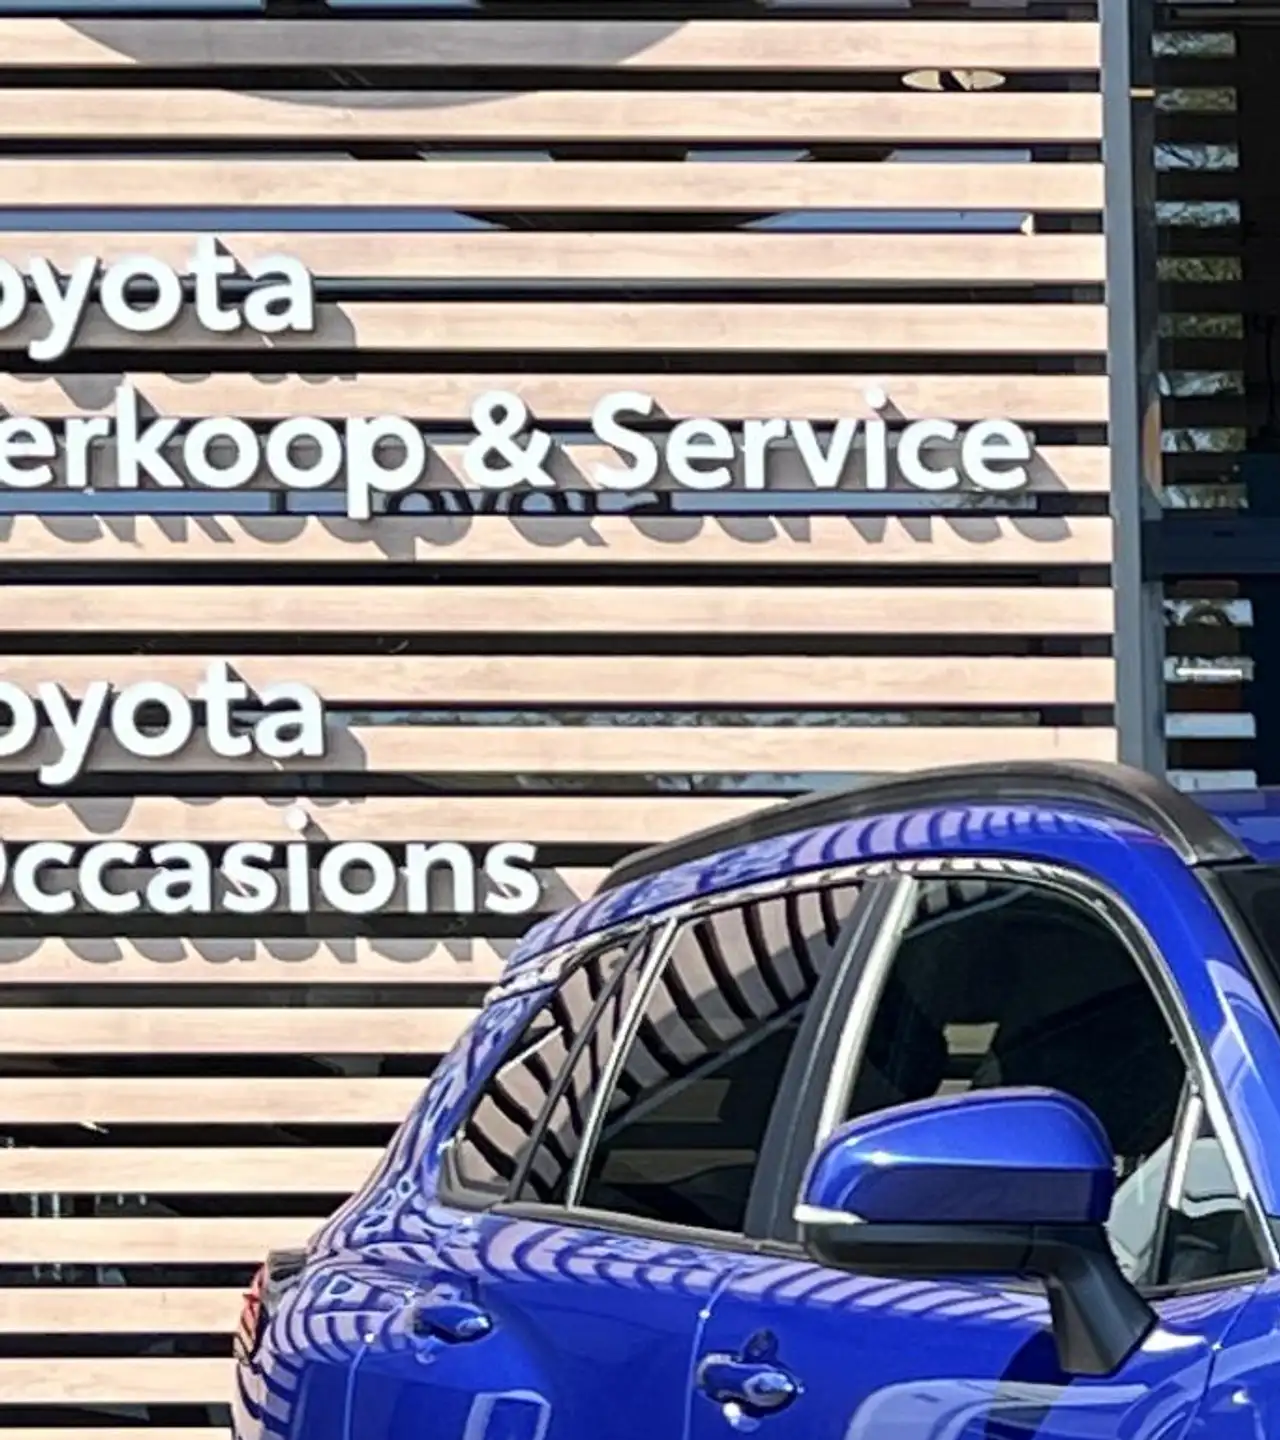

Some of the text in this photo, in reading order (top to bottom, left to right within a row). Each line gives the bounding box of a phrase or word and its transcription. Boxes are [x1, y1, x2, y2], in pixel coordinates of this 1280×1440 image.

[463, 390, 554, 489] &
[591, 386, 1031, 489] Service
[0, 808, 540, 914] ccasions
